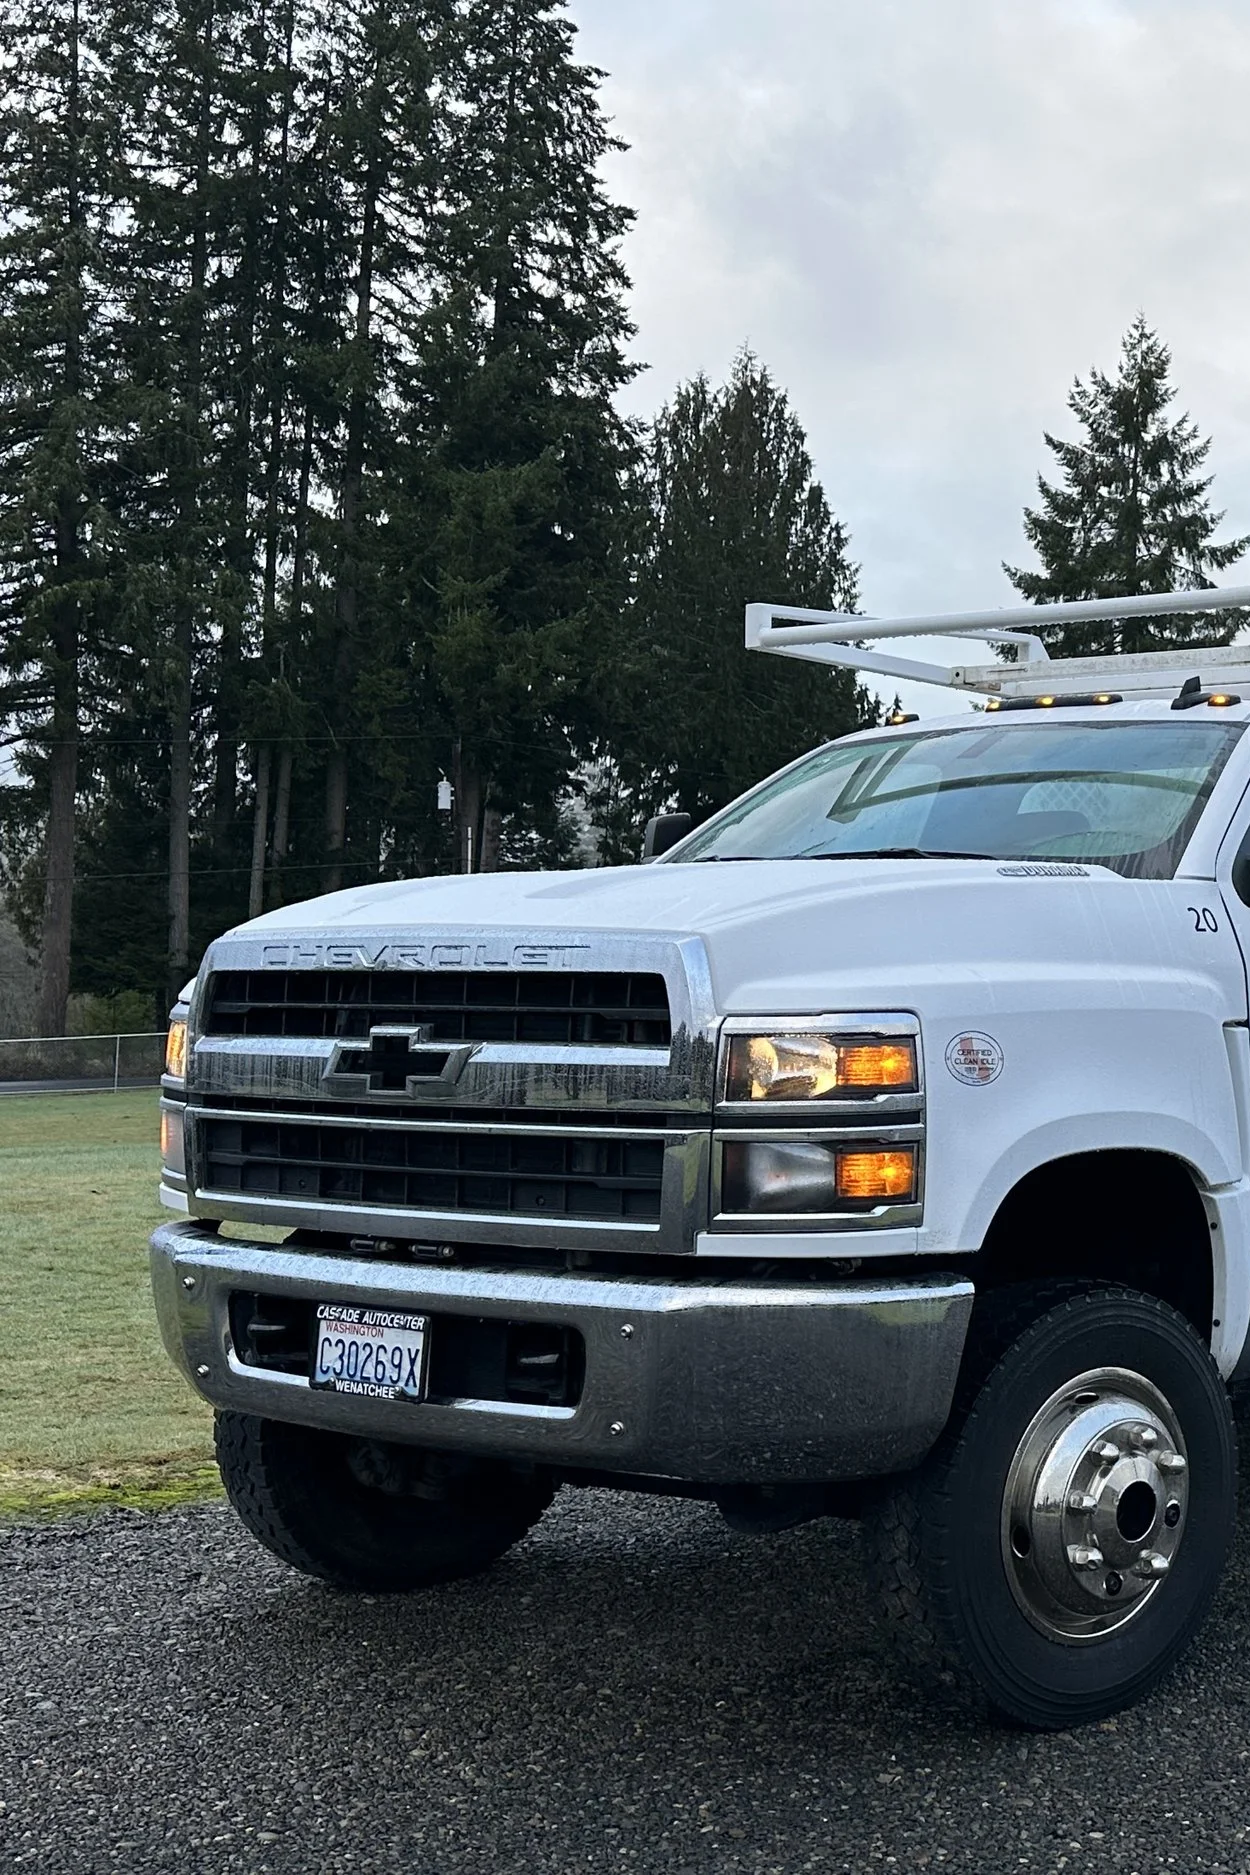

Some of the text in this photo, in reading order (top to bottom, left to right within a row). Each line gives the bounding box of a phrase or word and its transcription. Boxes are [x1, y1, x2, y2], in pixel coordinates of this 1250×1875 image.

[1187, 907, 1218, 932] 20
[260, 945, 591, 968] CHEVROLET
[325, 1320, 385, 1338] WASHINGTON
[320, 1336, 420, 1388] C30269X
[335, 1380, 396, 1399] WENATCHEE
